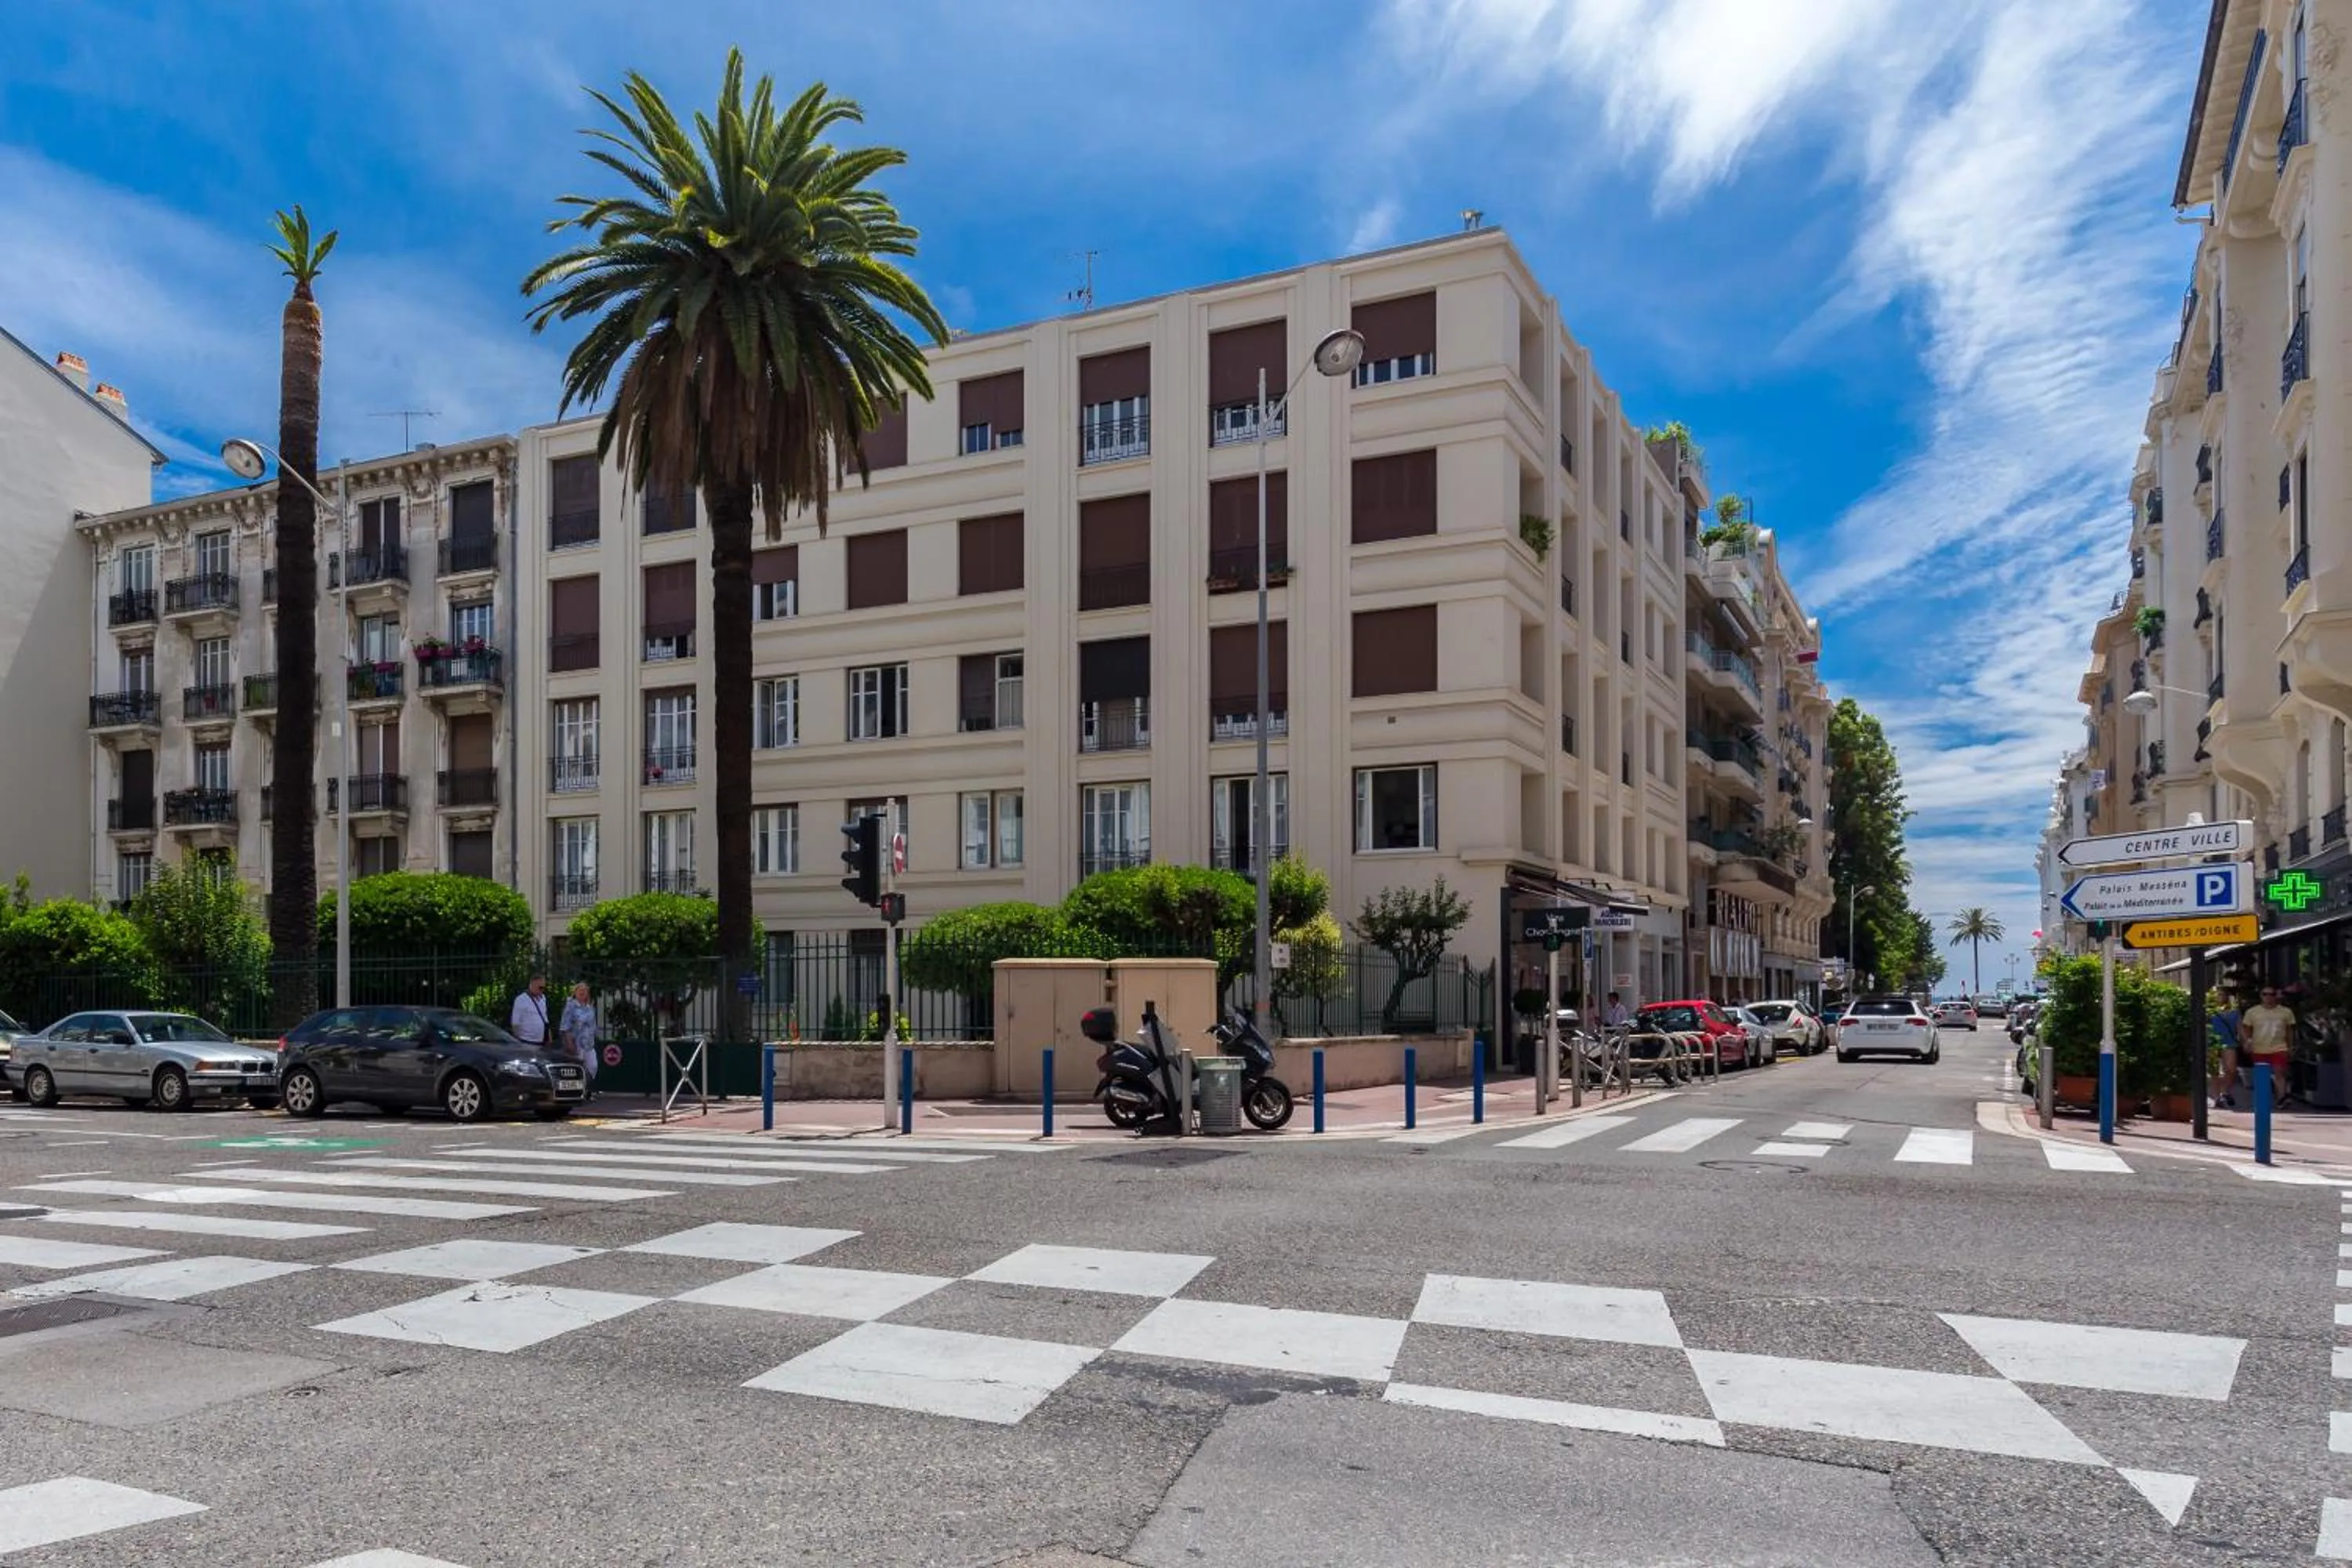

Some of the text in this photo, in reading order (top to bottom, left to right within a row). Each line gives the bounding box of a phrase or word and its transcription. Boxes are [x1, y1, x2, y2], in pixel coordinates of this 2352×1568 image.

[2125, 830, 2232, 853] CENTRE VILLE
[2204, 874, 2226, 904] P
[2140, 927, 2190, 938] ANTIBES
